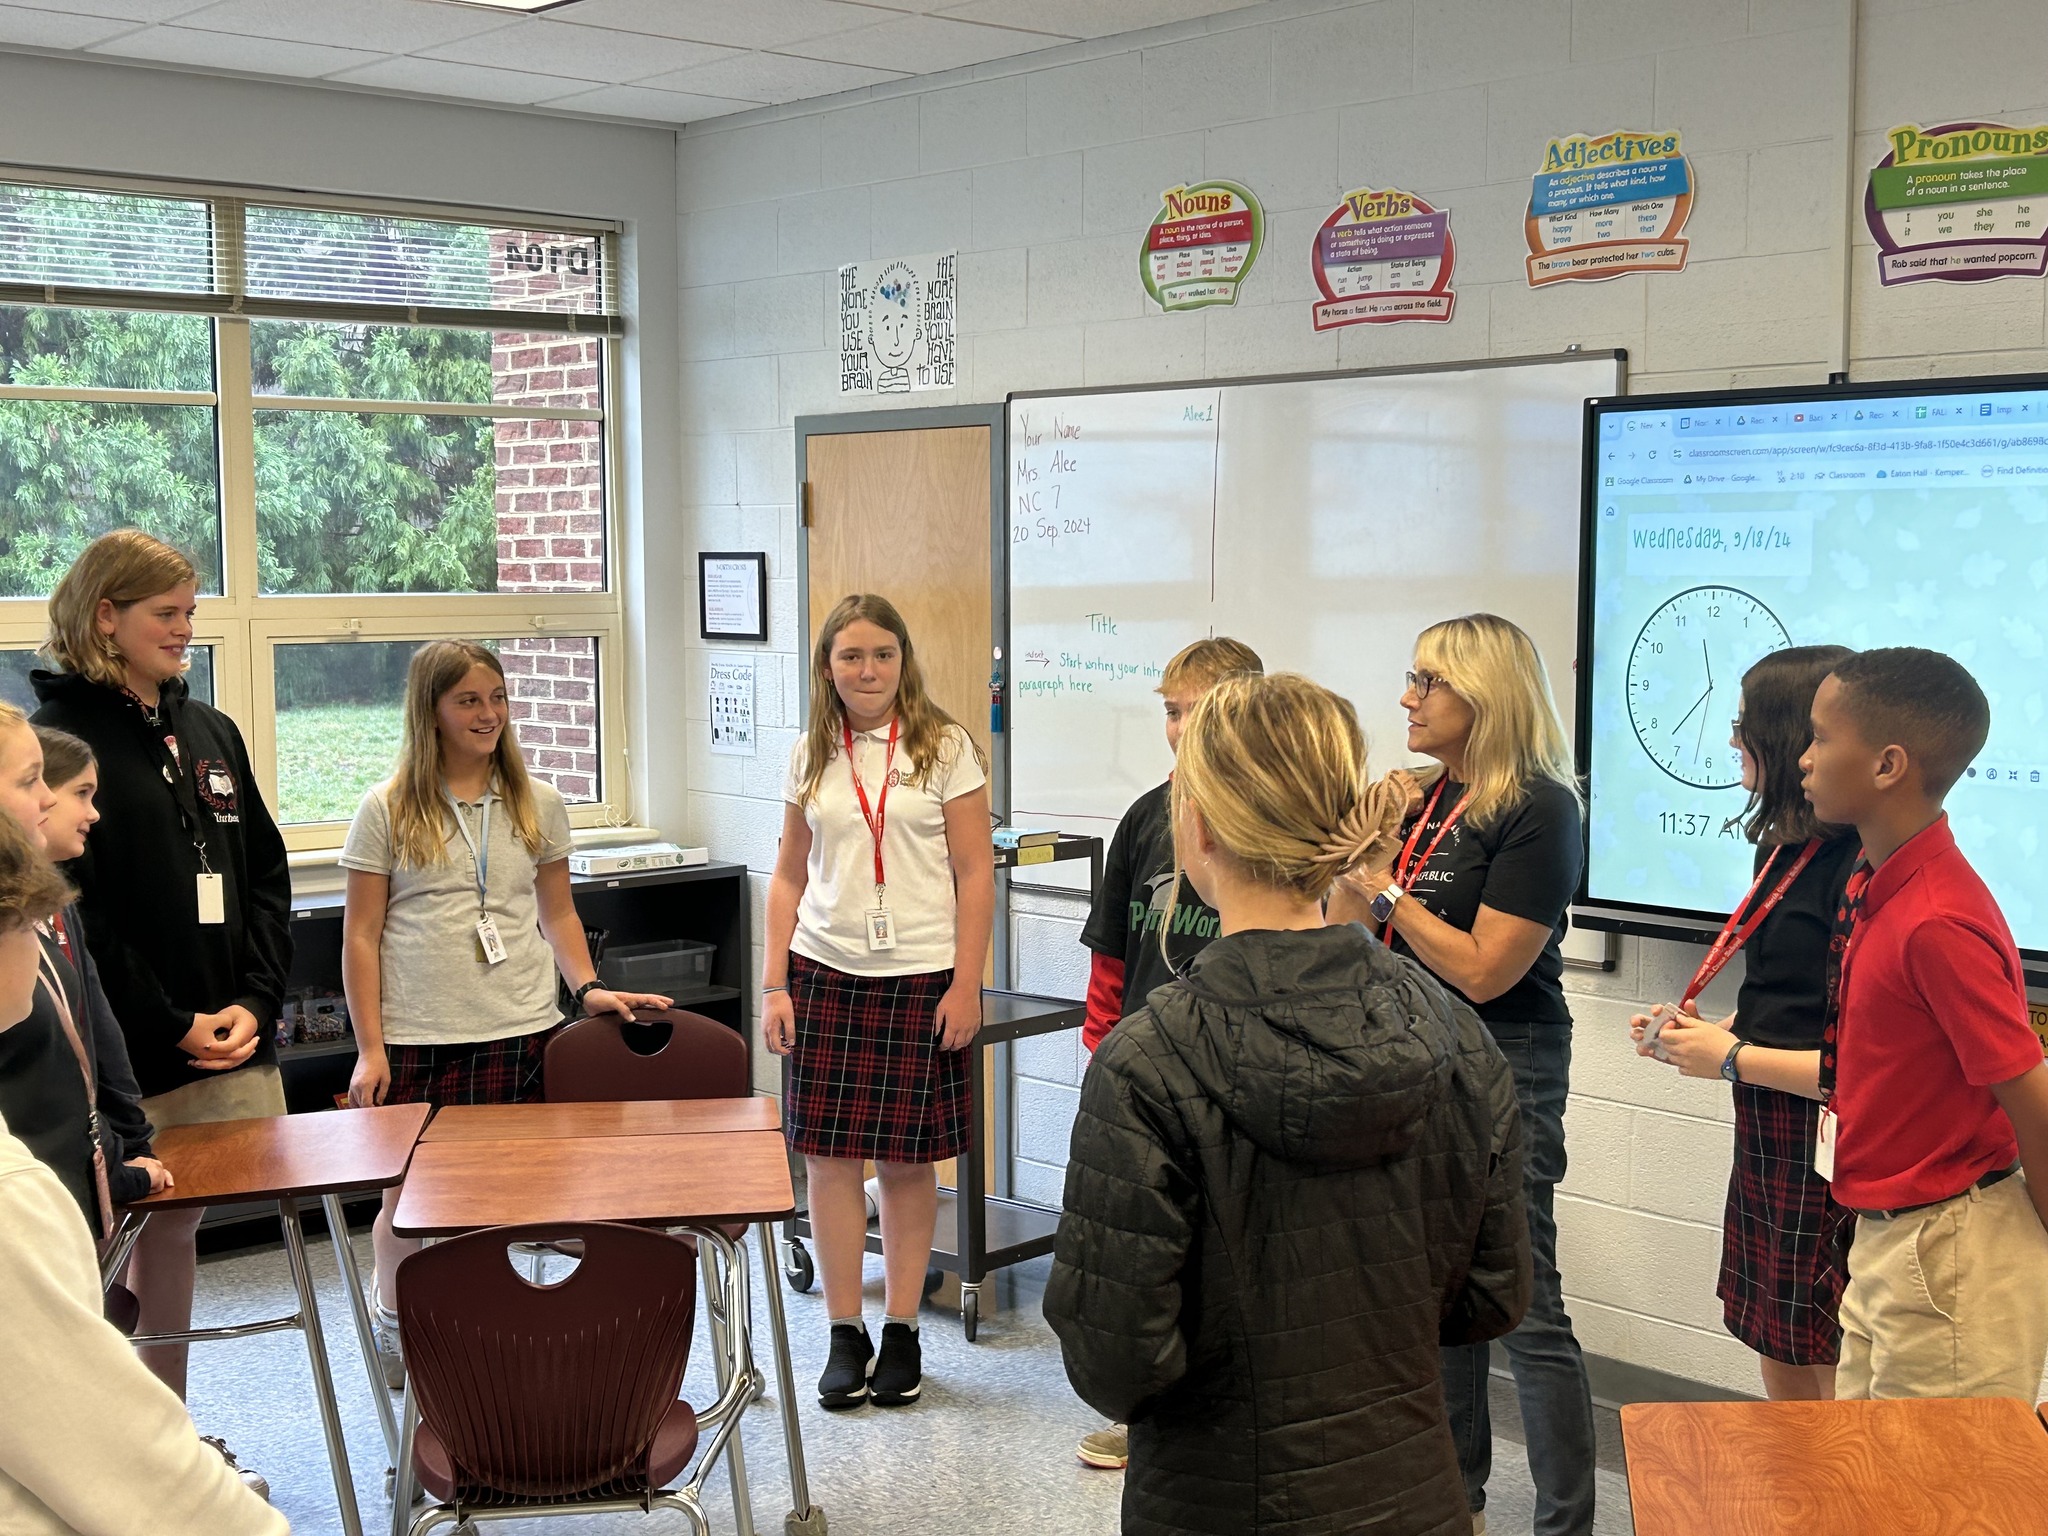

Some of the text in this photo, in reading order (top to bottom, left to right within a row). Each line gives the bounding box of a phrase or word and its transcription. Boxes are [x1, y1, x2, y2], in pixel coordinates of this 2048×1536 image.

[1545, 135, 1676, 172] Adjectives
[1891, 130, 2048, 164] Pronouns
[1906, 167, 2027, 186] A pronoun takes the place
[1906, 188, 1915, 196] of
[1926, 186, 1947, 194] noun
[1950, 184, 1958, 192] in
[1968, 181, 2010, 191] sentence.
[1165, 190, 1231, 220] Nouns
[1346, 193, 1410, 221] Verbs
[1938, 212, 1954, 222] you
[1977, 208, 1992, 217] she
[2018, 205, 2029, 214] he
[1905, 227, 1910, 236] it
[1974, 222, 1994, 232] they
[2015, 220, 2030, 228] me
[1552, 260, 1570, 269] brave
[1572, 258, 1588, 266] bear
[1590, 253, 1624, 265] protected
[1626, 252, 1638, 260] her
[1642, 250, 1655, 258] two
[1657, 248, 1676, 257] cubs.
[1892, 252, 2037, 268] Rob said that he wanted popcorn.
[1020, 412, 1080, 449] Your Name
[1050, 450, 1076, 473] Alee
[1829, 471, 1865, 479] Classroom
[1997, 466, 2012, 474] Find
[1019, 485, 1060, 514] NC 7
[1013, 526, 1028, 543] 20
[1064, 518, 1090, 534] 2024
[1634, 526, 1791, 552] Wednesday, 9/18/24
[1676, 616, 1686, 626] 11
[1707, 606, 1720, 618] 12
[1085, 613, 1118, 635] Title
[1744, 617, 1748, 628] 1
[1651, 643, 1663, 654] 10
[710, 667, 752, 680] Dress Code
[1060, 653, 1082, 669] Start
[1085, 657, 1114, 681] writing
[1118, 664, 1139, 679] your
[1019, 675, 1092, 697] paragraph here
[1642, 680, 1649, 691] 9
[1651, 718, 1658, 729] 8
[1674, 746, 1680, 756] 7
[1705, 758, 1712, 768] 6
[1659, 811, 1711, 836] 11:37
